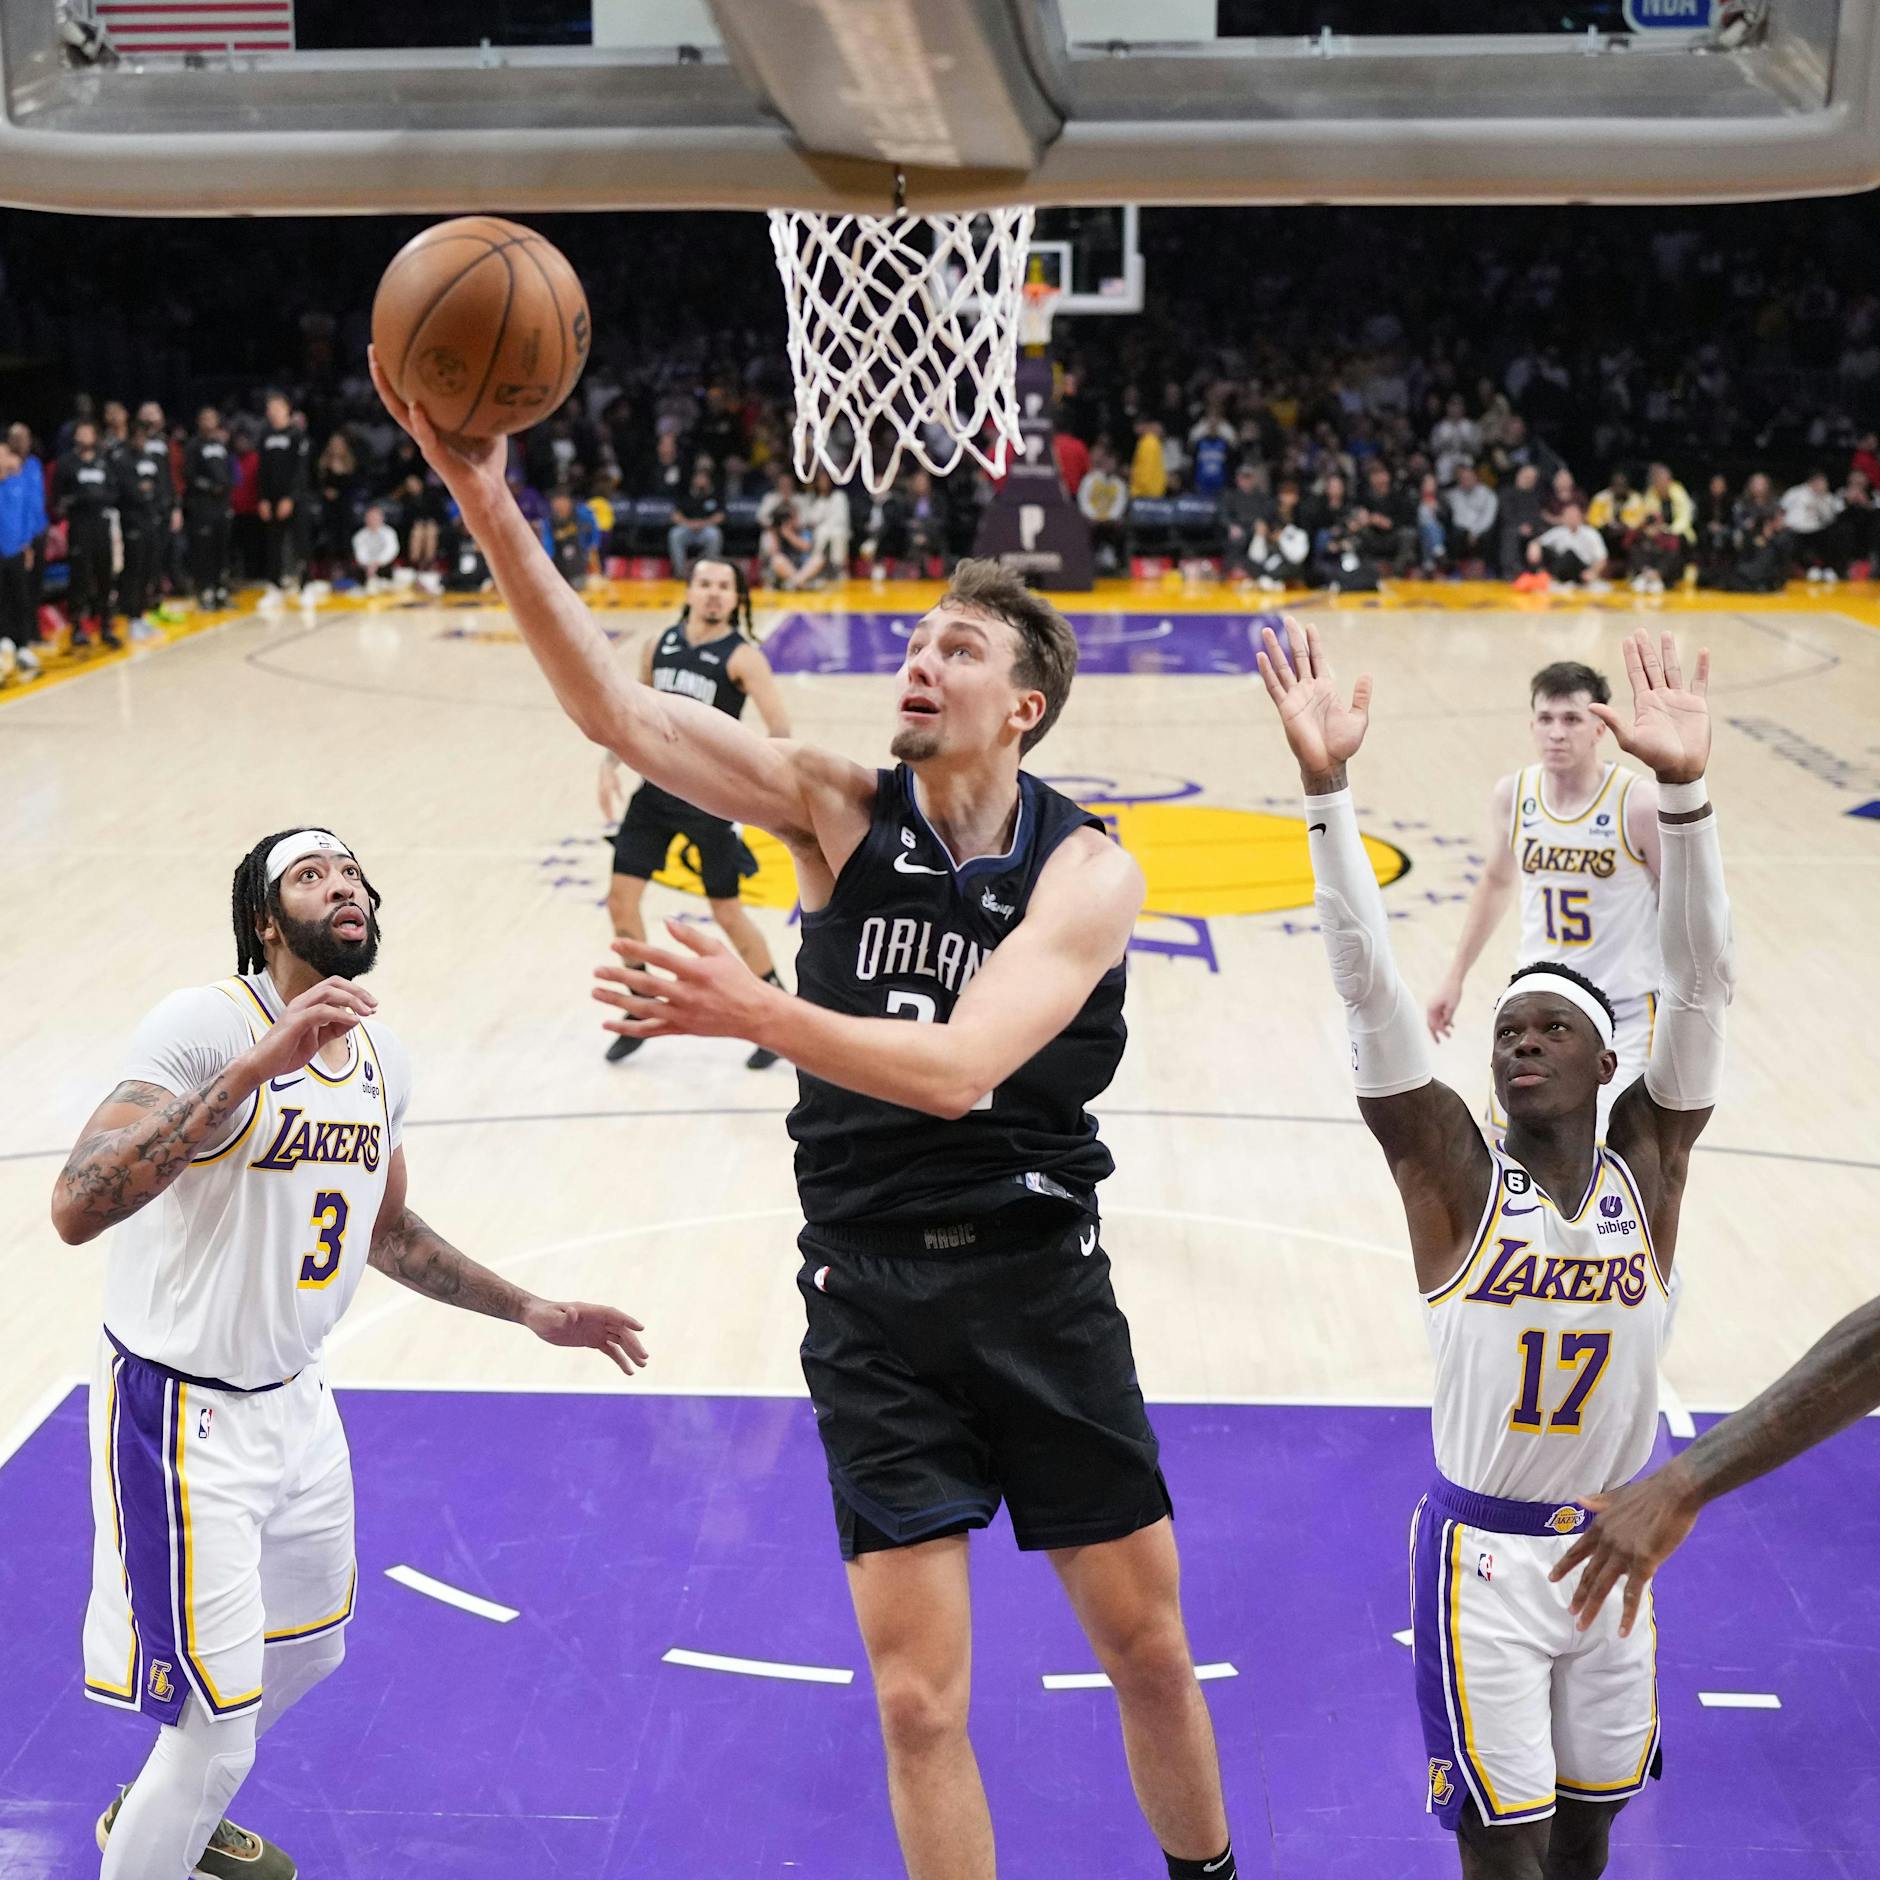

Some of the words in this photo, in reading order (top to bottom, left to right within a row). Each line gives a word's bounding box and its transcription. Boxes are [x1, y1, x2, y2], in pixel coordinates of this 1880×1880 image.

[900, 826, 917, 849] 6
[1521, 837, 1617, 878] LAKERS
[1542, 886, 1594, 946] 15
[856, 917, 993, 995] ORLAN
[248, 1106, 382, 1174] LAKERS
[1507, 1172, 1525, 1192] 6
[296, 1189, 350, 1290] 3
[923, 1222, 977, 1250] MAGIC
[1596, 1218, 1637, 1235] bibigo
[1463, 1237, 1649, 1310] LAKERS
[1509, 1327, 1614, 1436] 17
